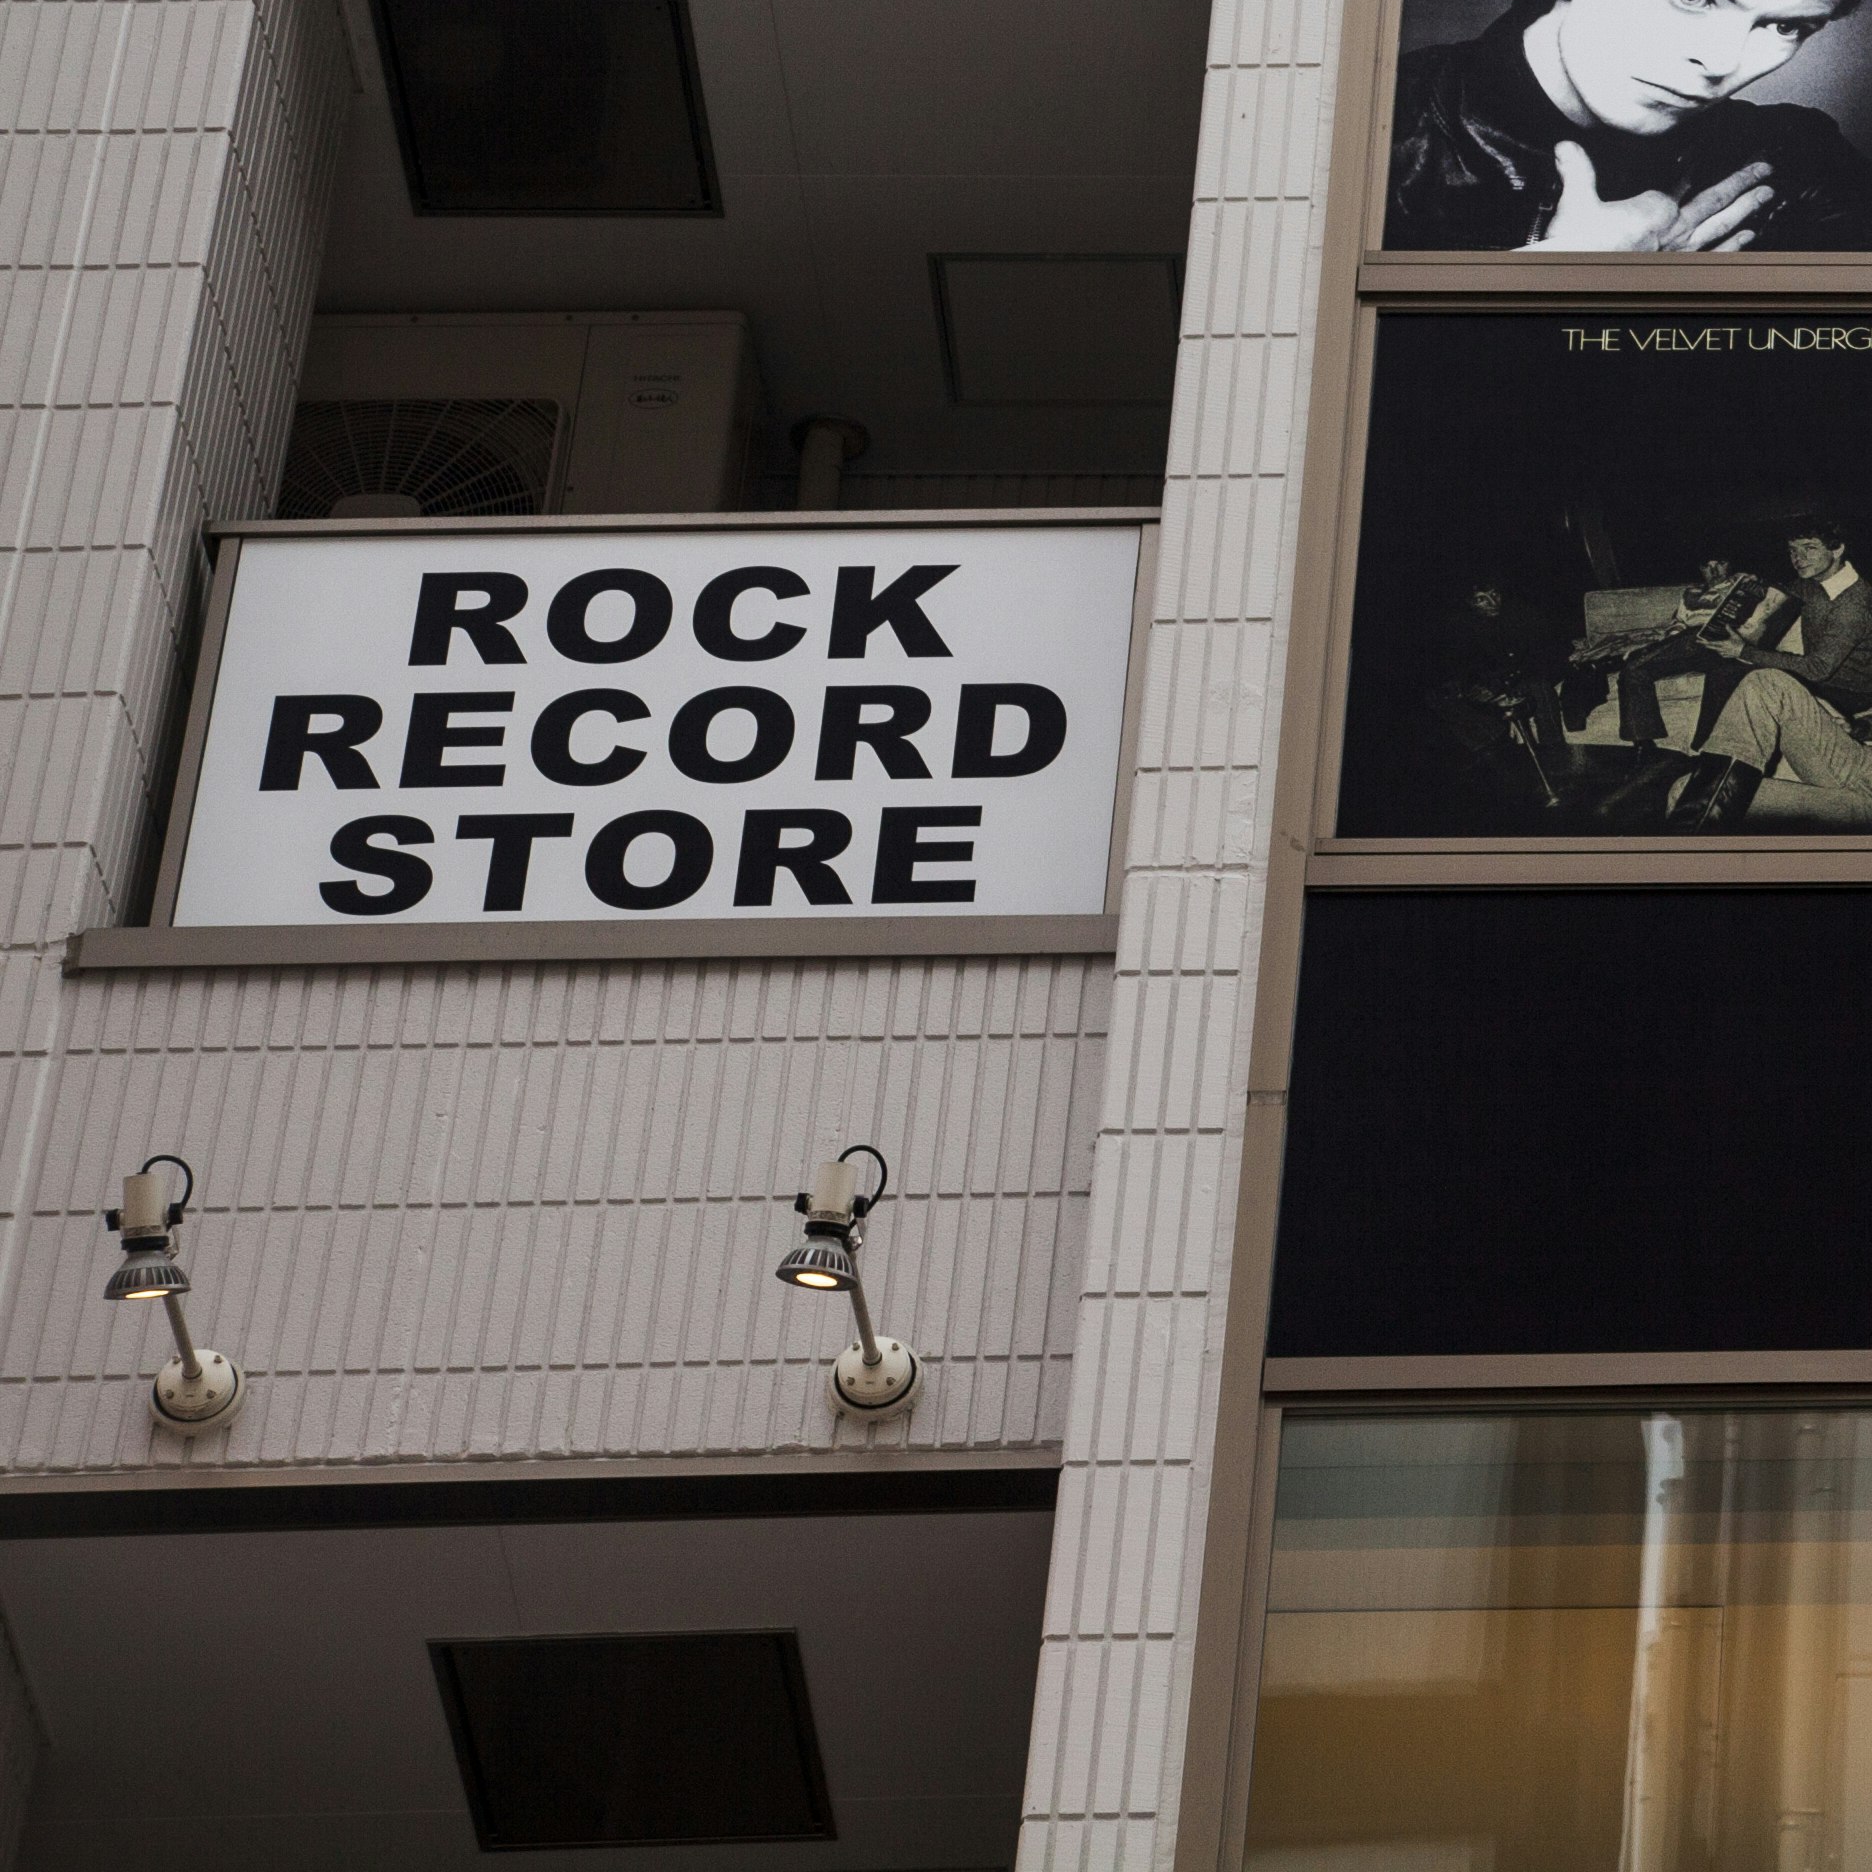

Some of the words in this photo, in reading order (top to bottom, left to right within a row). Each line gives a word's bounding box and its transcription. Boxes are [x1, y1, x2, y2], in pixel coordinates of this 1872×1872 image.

[1562, 329, 1620, 350] THE
[1629, 328, 1741, 350] VELVET
[408, 565, 960, 666] ROCK
[259, 683, 1067, 791] RECORD
[319, 806, 982, 915] STORE
